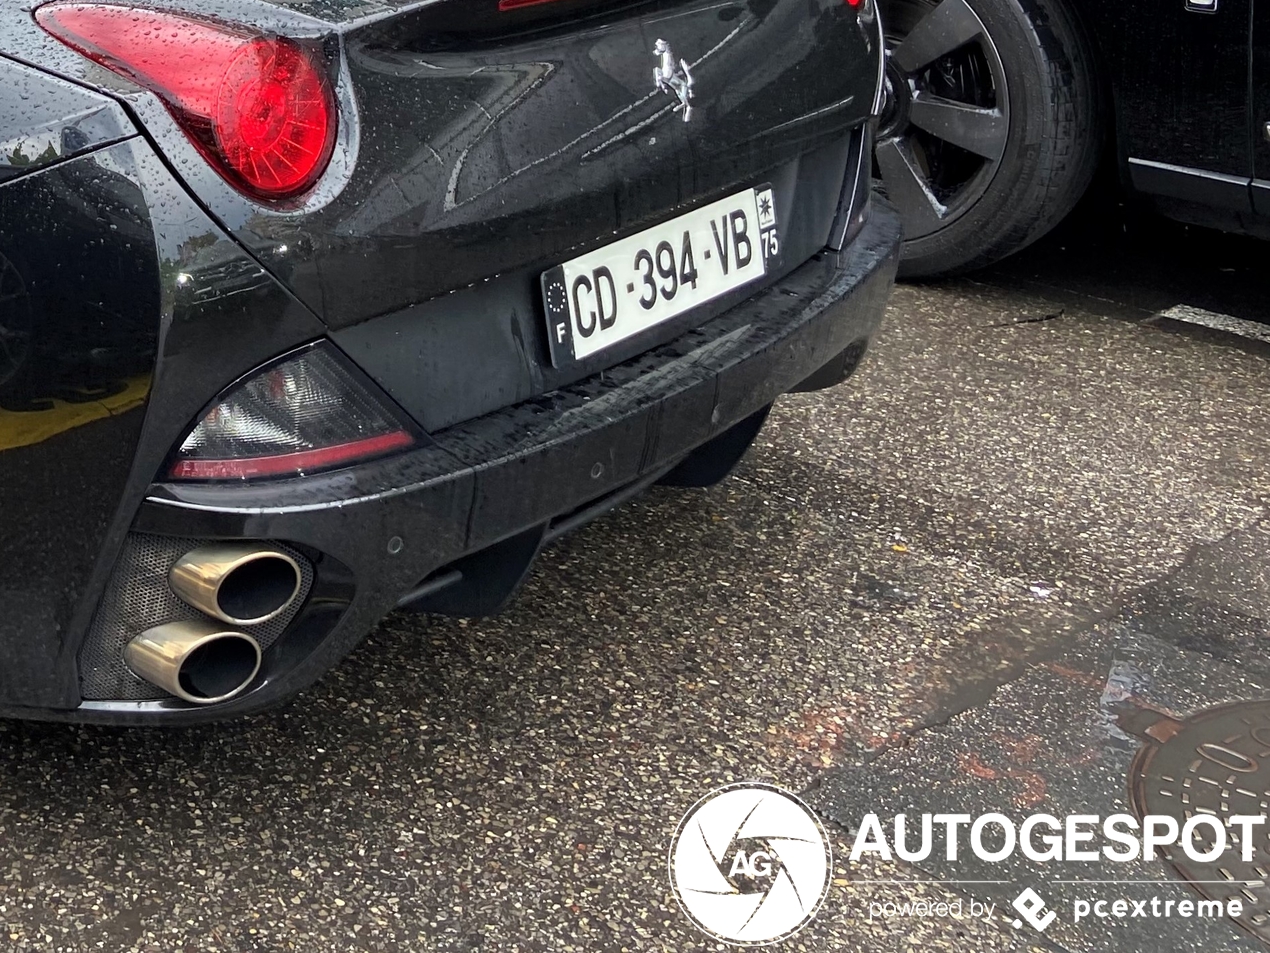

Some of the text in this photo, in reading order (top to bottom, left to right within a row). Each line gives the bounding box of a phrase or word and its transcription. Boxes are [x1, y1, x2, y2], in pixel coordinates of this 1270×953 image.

[761, 228, 779, 258] 75
[572, 208, 752, 339] CD-394-VB
[556, 322, 566, 344] F
